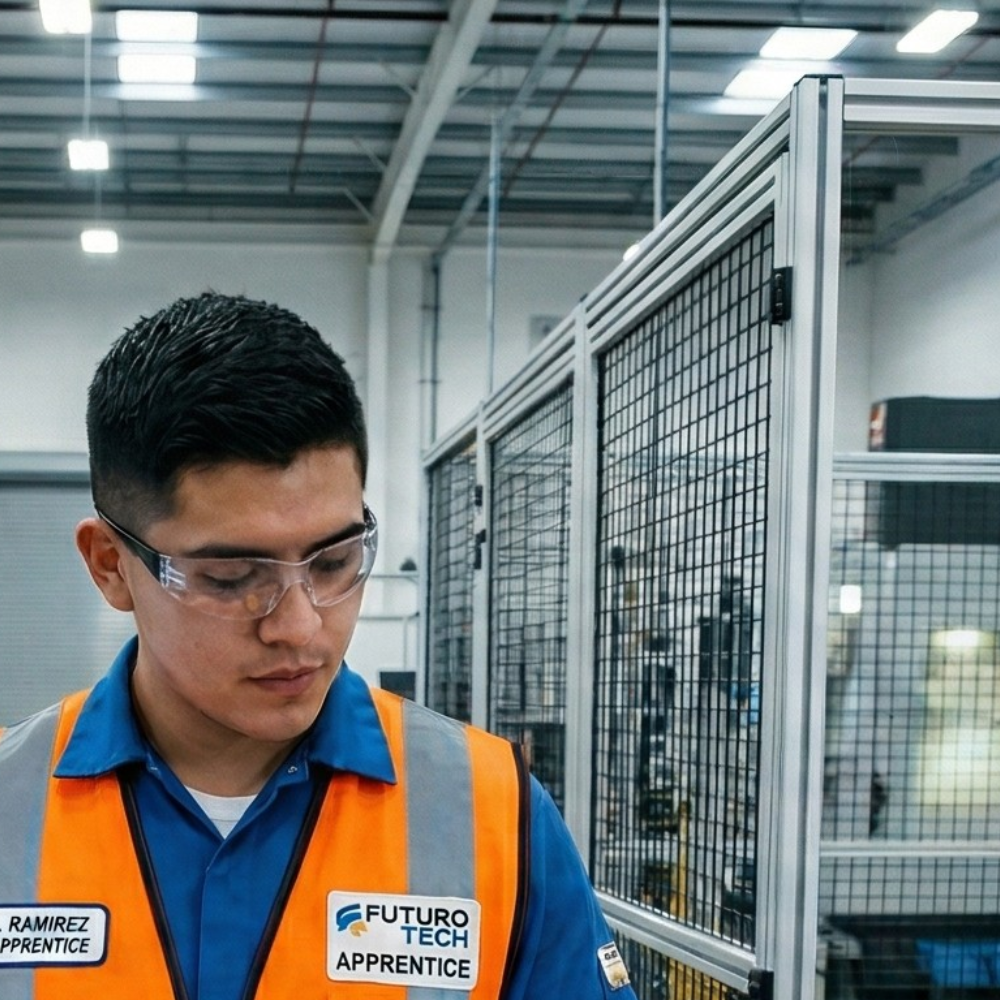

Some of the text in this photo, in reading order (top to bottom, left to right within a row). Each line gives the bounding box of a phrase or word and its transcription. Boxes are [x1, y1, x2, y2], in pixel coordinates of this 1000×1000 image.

[8, 916, 90, 932] RAMIREZ
[366, 904, 469, 928] FUTURO
[401, 926, 469, 948] TECH
[336, 951, 471, 979] APPRENTICE
